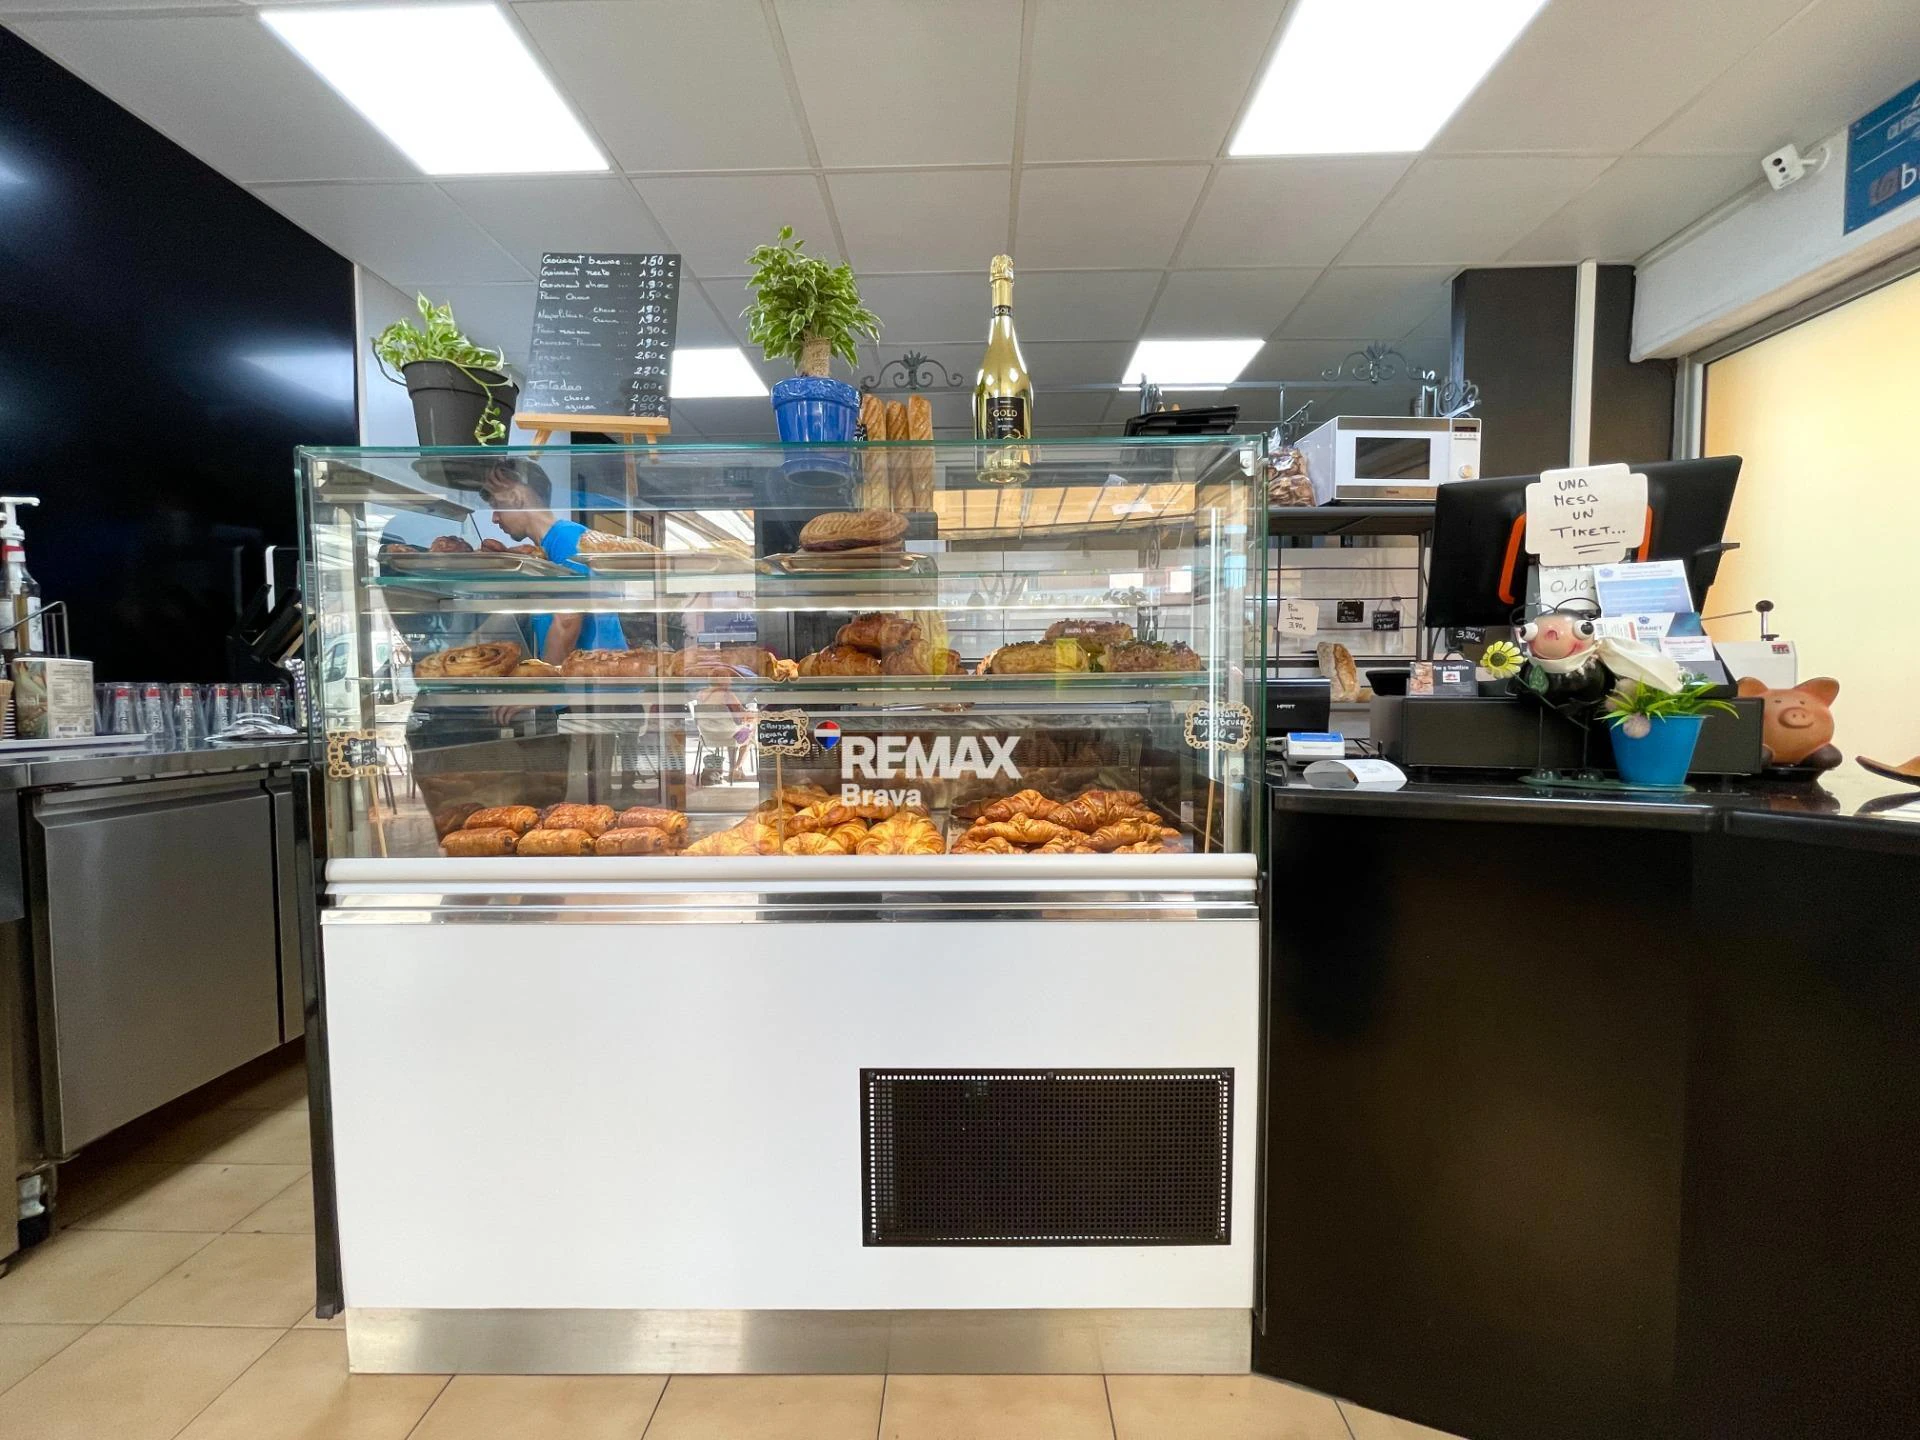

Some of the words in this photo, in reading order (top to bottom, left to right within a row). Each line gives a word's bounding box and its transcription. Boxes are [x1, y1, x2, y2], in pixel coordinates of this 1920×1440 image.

[992, 409, 1018, 417] GOLD
[1558, 479, 1588, 491] UNA
[1573, 508, 1594, 520] UN
